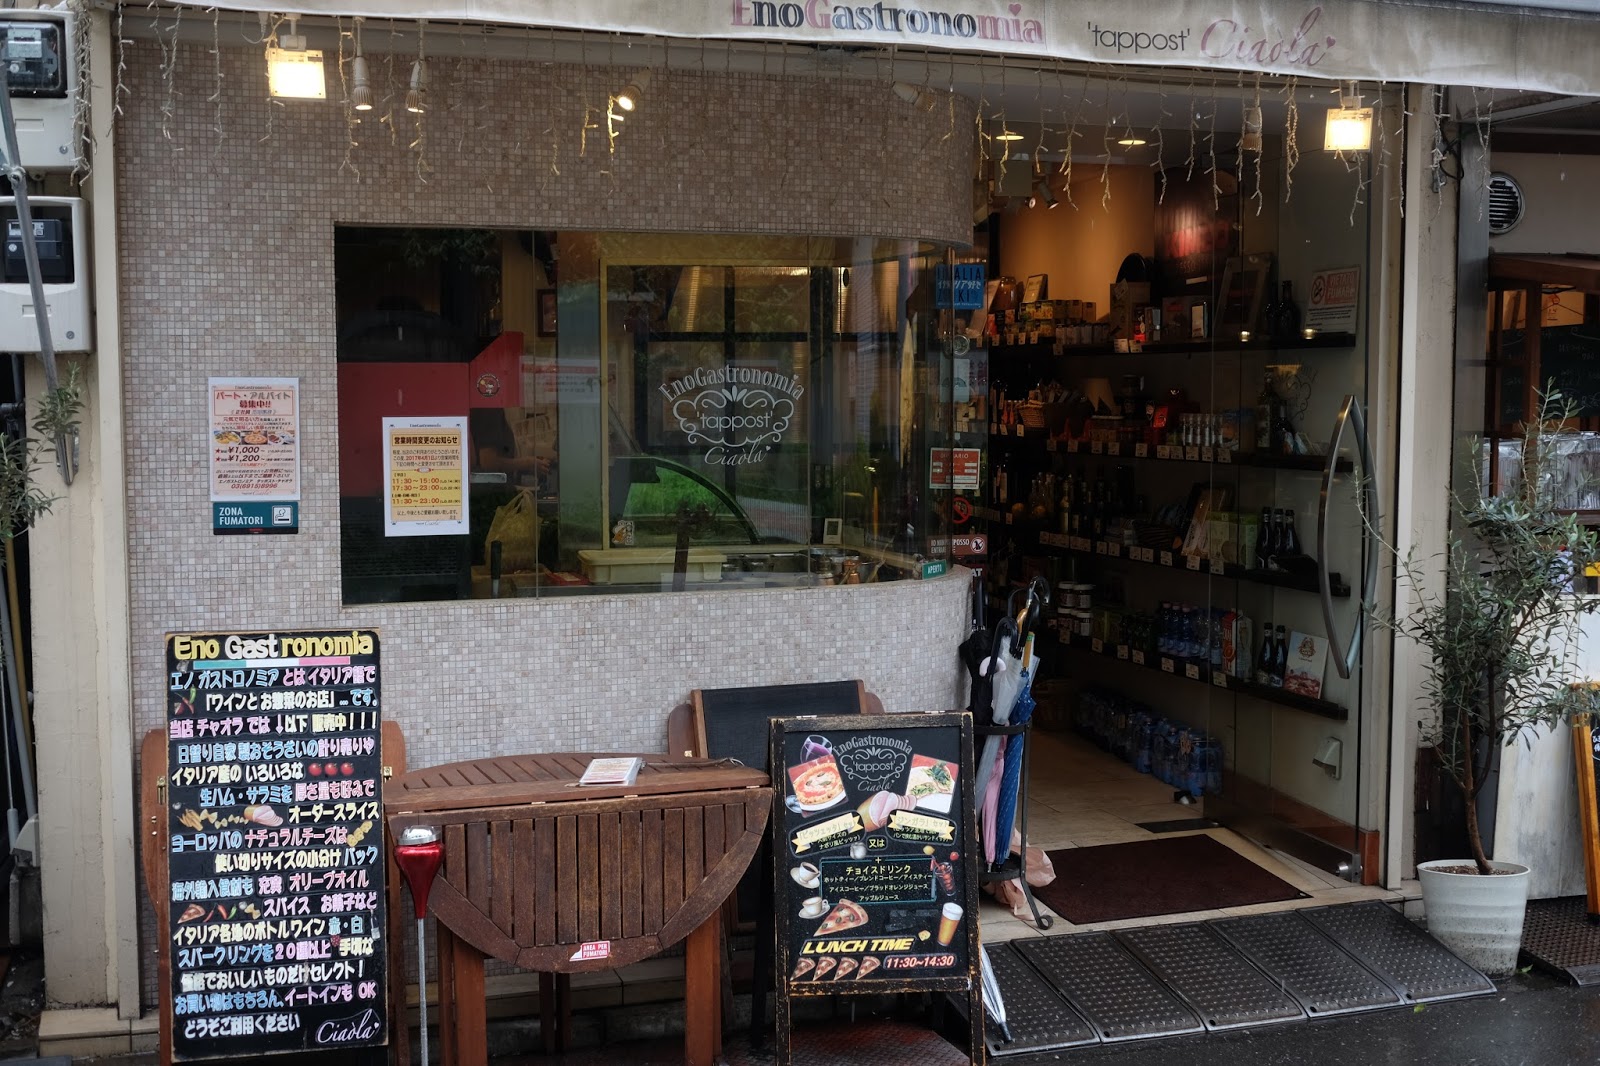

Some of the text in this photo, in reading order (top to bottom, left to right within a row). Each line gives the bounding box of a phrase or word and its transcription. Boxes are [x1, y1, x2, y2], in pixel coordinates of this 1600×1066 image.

[731, 0, 1045, 43] EnoGastronomia
[1087, 21, 1190, 53] 'tappost'
[658, 363, 805, 403] EnoGastronomia
[696, 410, 773, 432] 'tappost'
[394, 436, 458, 445] 営業時間変更のお知らせ
[219, 507, 243, 516] ZONA
[219, 516, 263, 525] FUMATORI
[174, 635, 220, 660] Eno
[832, 734, 913, 757] EnoGastronomia
[288, 802, 380, 824] オーダースライス
[868, 838, 885, 848] 又は
[845, 864, 912, 875] チョイスドリンク
[289, 869, 370, 892] オリーブオイル
[320, 891, 378, 913] お菓子など
[859, 894, 900, 902] アップルジュース
[583, 950, 608, 958] FUMATORI
[802, 938, 916, 955] LUNCH TIME
[357, 981, 377, 999] OK
